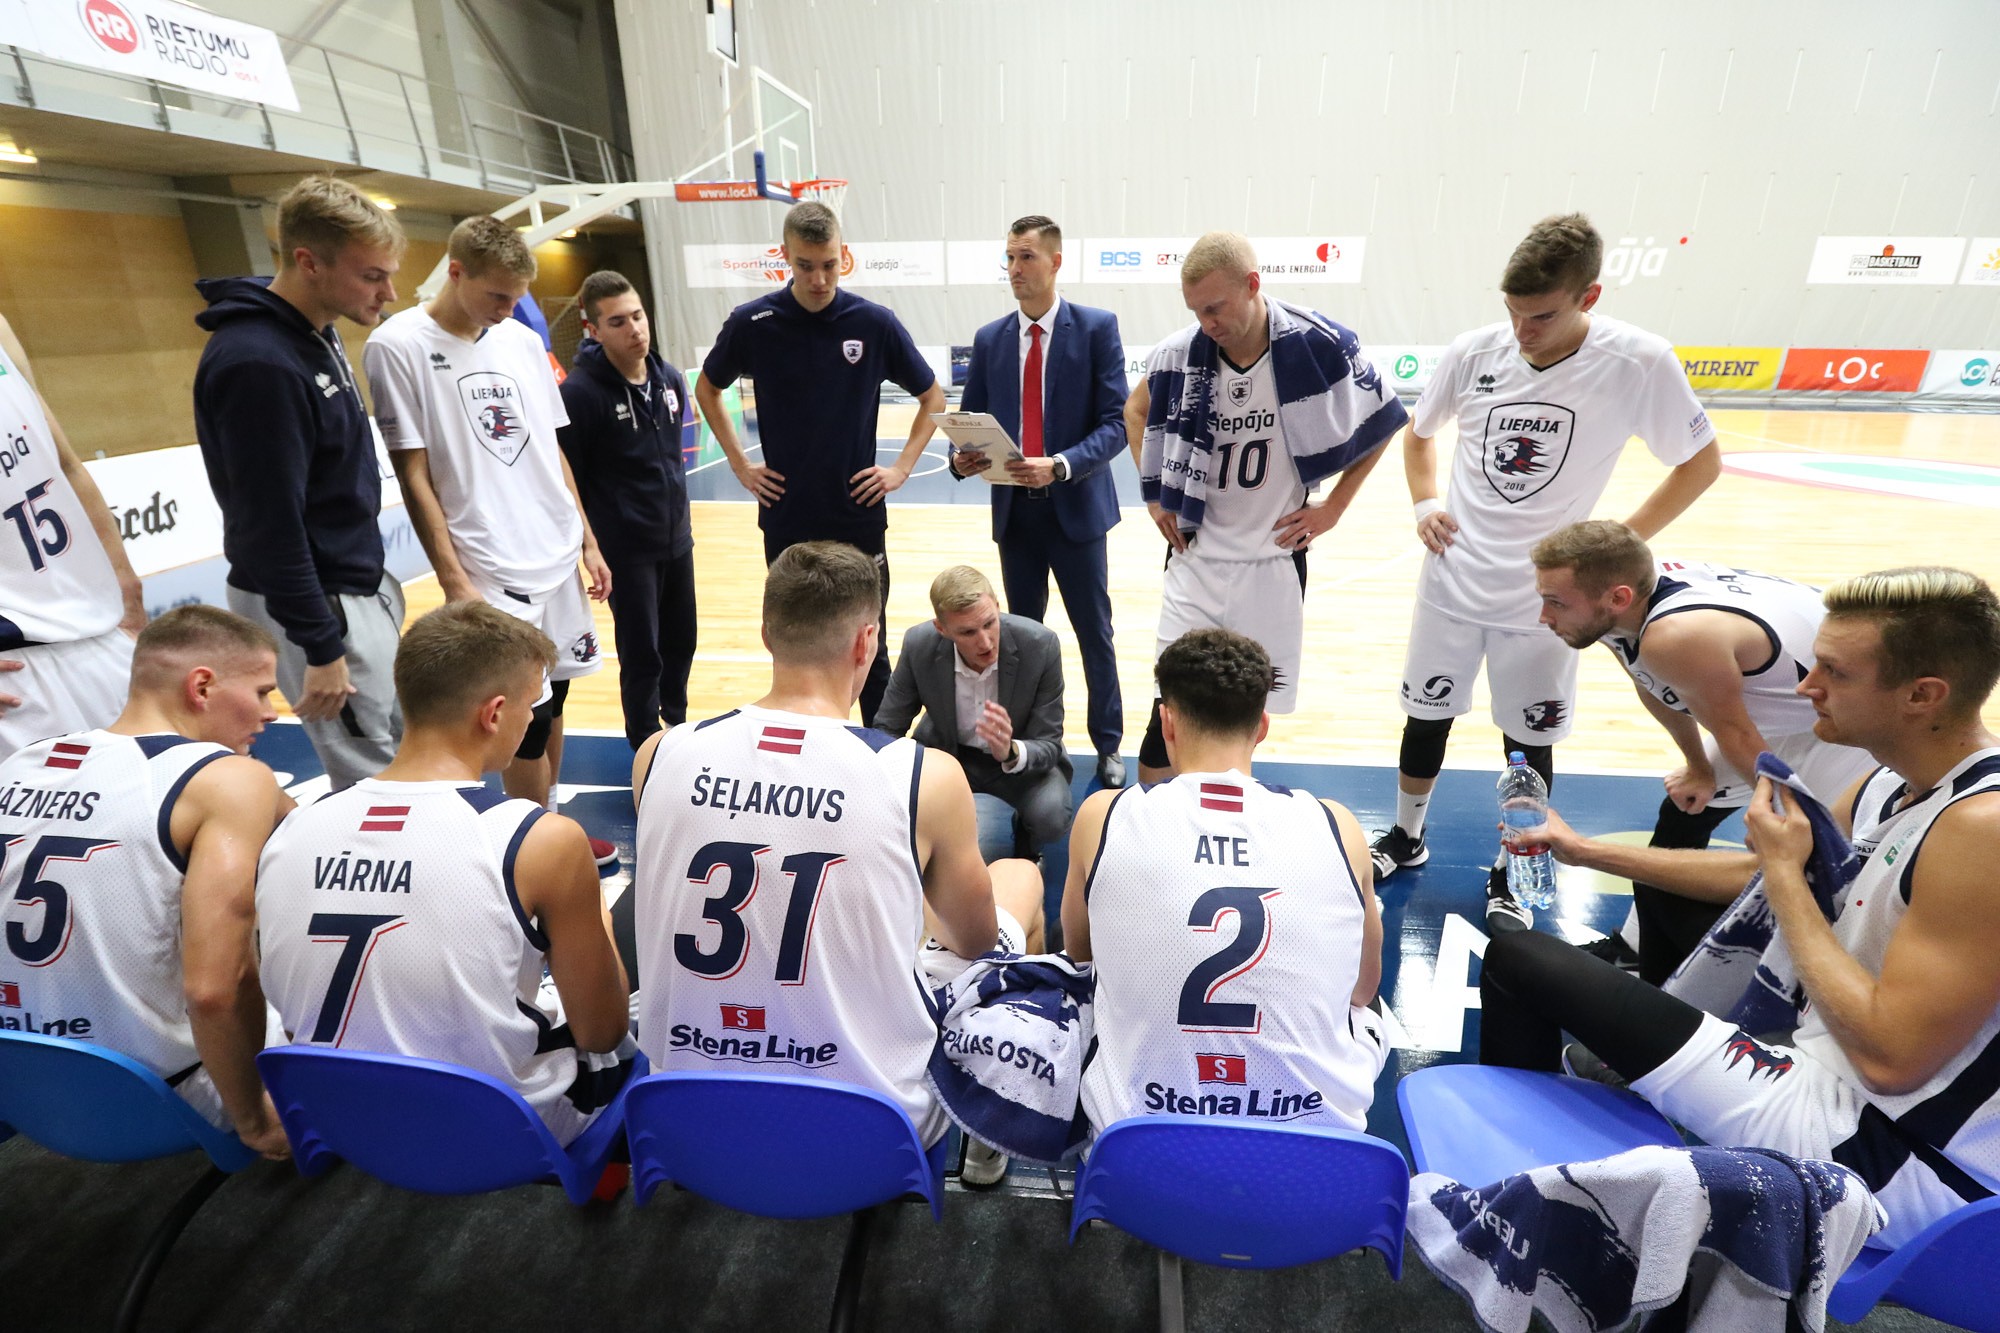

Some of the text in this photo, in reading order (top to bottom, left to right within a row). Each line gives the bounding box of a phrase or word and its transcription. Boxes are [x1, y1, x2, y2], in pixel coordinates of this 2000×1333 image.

[88, 9, 135, 43] RR
[145, 14, 250, 60] RIETUMU
[154, 40, 228, 76] RADIO
[1100, 251, 1141, 266] BCS
[1868, 256, 1921, 268] BASKETBALL
[1683, 361, 1759, 377] MIRENT
[1824, 357, 1883, 384] LOC
[472, 384, 513, 400] LIEPĀJA
[1499, 416, 1562, 433] LIEPĀJA
[1217, 438, 1275, 492] 10
[1504, 482, 1526, 491] 2018
[3, 478, 54, 573] 15
[1413, 698, 1450, 707] ekovalis
[0, 781, 101, 822] ĀZNERS
[690, 767, 846, 823] ŠEĻAKOVS
[1194, 835, 1250, 867] ATE
[314, 851, 413, 894] VĀRNA
[674, 841, 848, 986] 31
[1177, 886, 1284, 1034] 2
[307, 913, 408, 1048] 7
[669, 1024, 838, 1063] Stena Line
[997, 1040, 1056, 1088] OSTA
[1144, 1082, 1323, 1117] Stena Line
